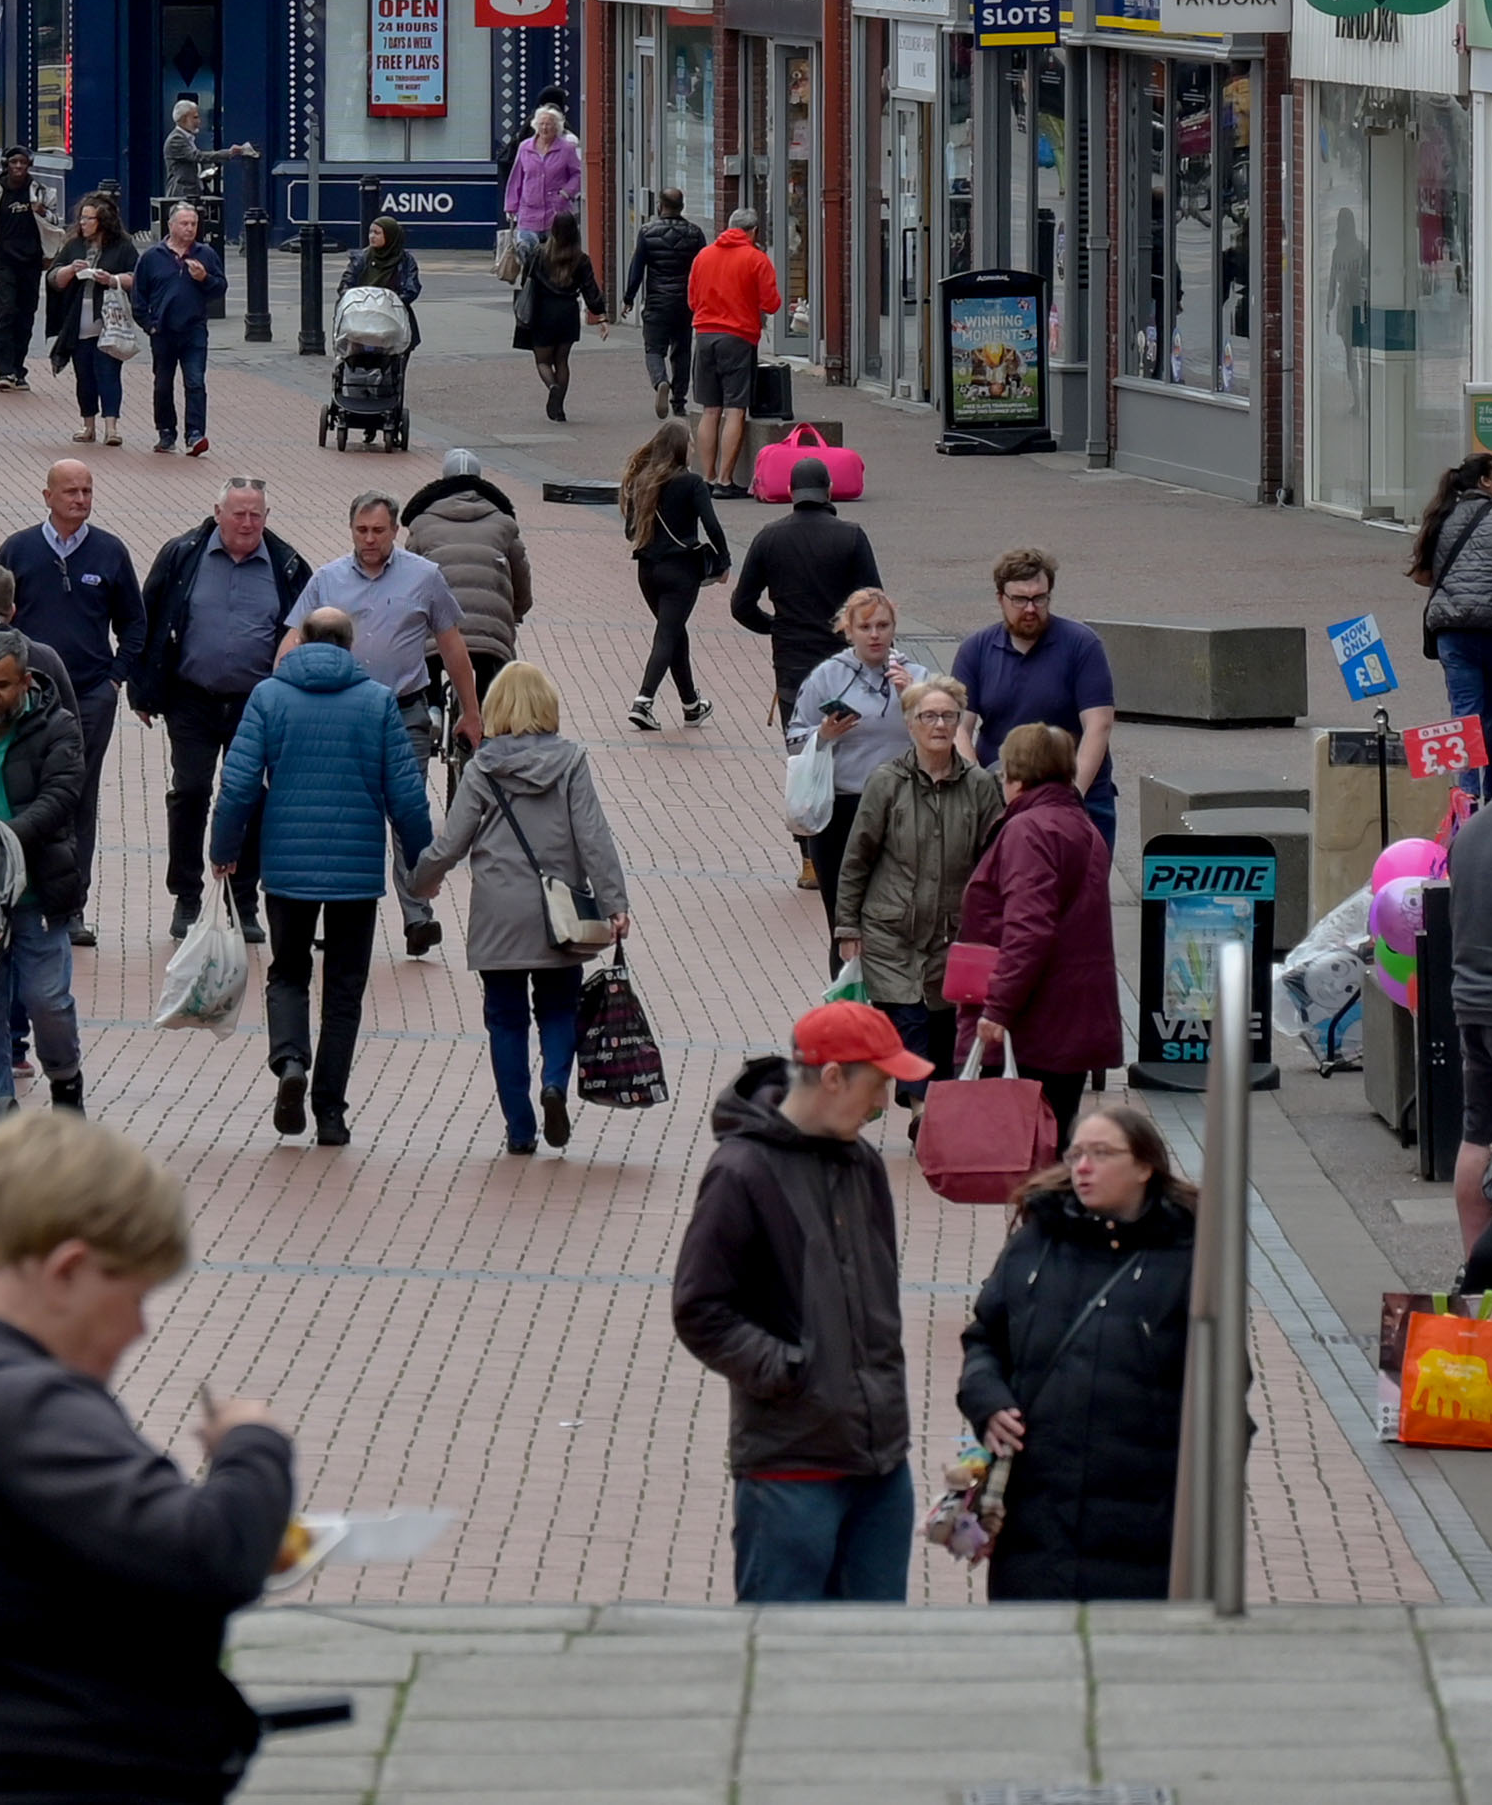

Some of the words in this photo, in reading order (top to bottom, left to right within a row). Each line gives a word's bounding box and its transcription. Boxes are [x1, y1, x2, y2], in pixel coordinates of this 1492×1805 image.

[982, 7, 1051, 26] SLOTS
[378, 22, 393, 32] 24
[396, 22, 438, 32] HOURS
[390, 37, 407, 49] DAYS
[414, 37, 432, 49] WEEK
[377, 55, 403, 70] FREE
[405, 55, 439, 70] PLAYS
[964, 315, 1023, 327] WINNING
[962, 329, 1026, 342] MOMENTS
[1340, 621, 1367, 645] NOW
[1343, 634, 1372, 659] ONLY
[1422, 724, 1461, 737] ONLY
[1421, 737, 1468, 775] £3
[1148, 866, 1269, 892] PRIME
